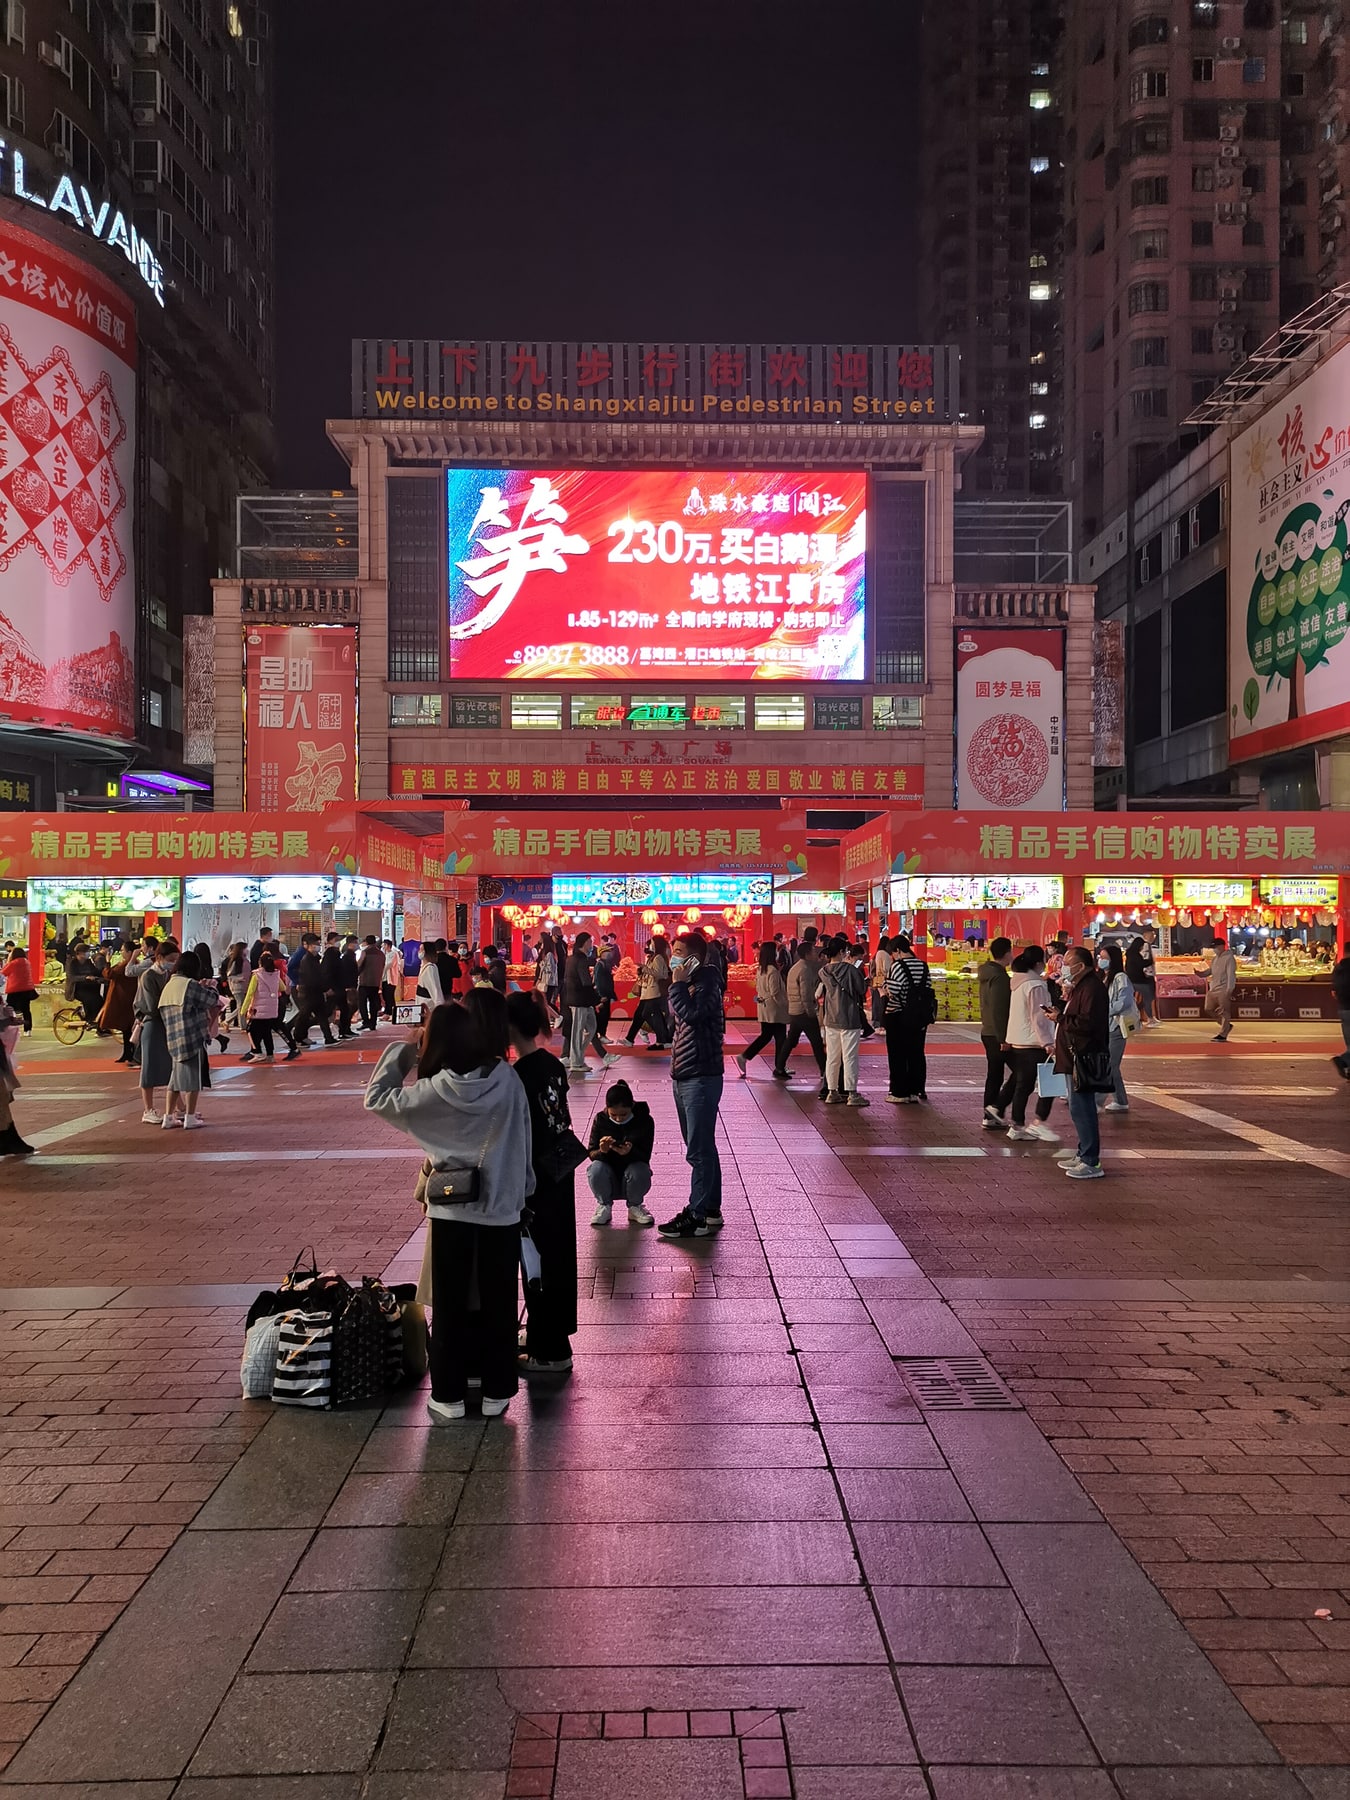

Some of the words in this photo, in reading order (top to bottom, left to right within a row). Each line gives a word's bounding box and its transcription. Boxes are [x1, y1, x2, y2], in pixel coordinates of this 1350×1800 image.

[375, 346, 934, 390] 上下九步行街欢迎您
[53, 371, 68, 417] 文明
[375, 391, 499, 410] Welcome
[505, 394, 526, 410] to
[537, 393, 695, 415] Shangxiajiu
[703, 395, 842, 414] Pedestrian
[852, 396, 936, 414] Street
[53, 445, 69, 490] 公正
[1260, 464, 1302, 509] 社会主义
[53, 516, 69, 561] 诚信
[100, 534, 111, 577] 友善
[690, 572, 846, 605] 地铁江景房
[1300, 613, 1321, 637] 诚信
[1325, 601, 1348, 627] 友善
[523, 645, 574, 666] 8937
[578, 646, 630, 666] 3888
[975, 681, 1042, 699] 圆梦是福
[585, 740, 733, 757] 上下九广场
[402, 769, 436, 790] 富强
[444, 769, 478, 790] 民主
[487, 769, 521, 790] 文明
[532, 769, 567, 790] 和谐
[577, 769, 609, 790] 自由
[619, 769, 654, 790] 平等
[662, 769, 696, 790] 公正
[704, 769, 738, 790] 法治
[746, 769, 780, 791] 爱国
[788, 769, 823, 791] 敬业
[832, 769, 865, 791] 诚信
[873, 769, 907, 791] 友善
[31, 830, 309, 860] 精品手信购物特卖展
[492, 828, 762, 857] 精品手信购物特卖展
[979, 825, 1317, 860] 精品手信购物特卖展
[1231, 987, 1276, 1002] 干牛肉
